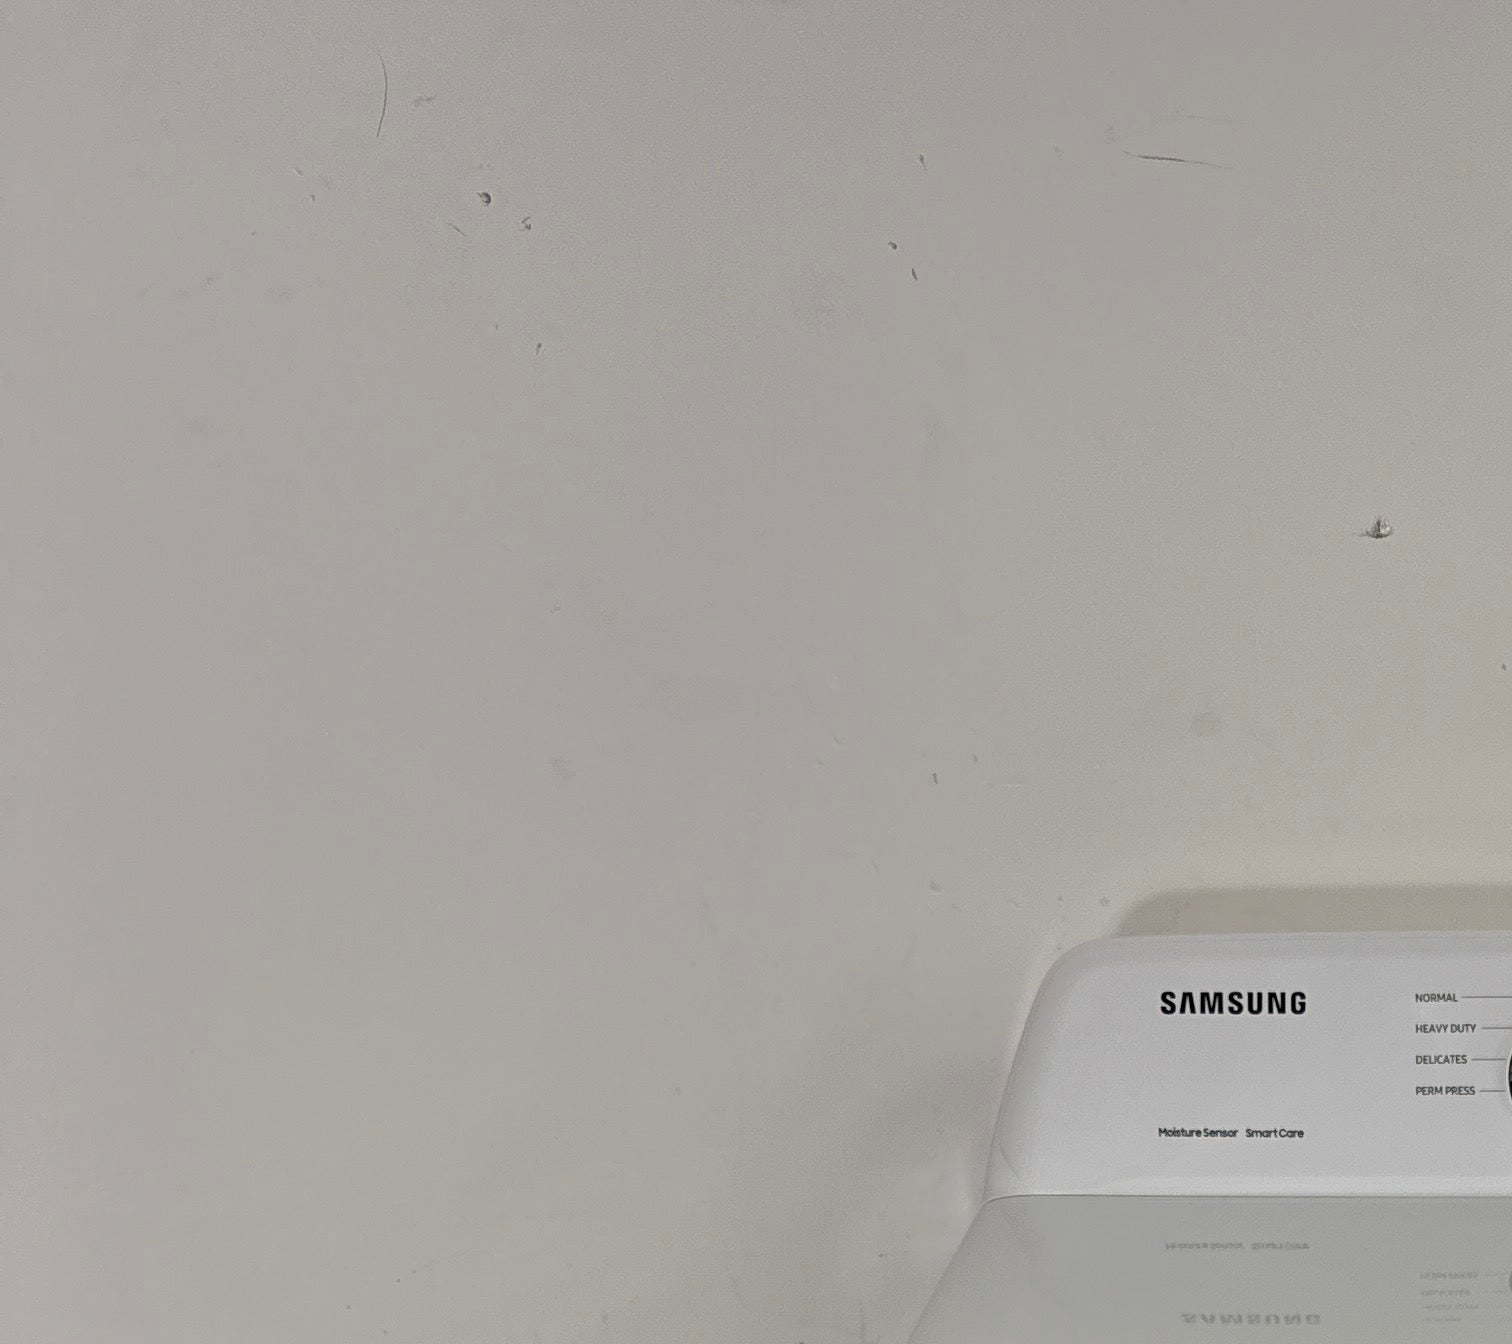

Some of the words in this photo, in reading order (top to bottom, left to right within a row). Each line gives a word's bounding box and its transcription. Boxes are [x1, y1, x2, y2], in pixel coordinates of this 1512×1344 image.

[1415, 993, 1458, 1002] NORMAL
[1160, 991, 1307, 1015] SAMSUNG
[1415, 1024, 1448, 1033] HEAVY
[1450, 1024, 1477, 1033] DUTY
[1415, 1055, 1468, 1065] DELICATES
[1415, 1086, 1443, 1096] PERM
[1445, 1086, 1476, 1096] PRESS
[1158, 1127, 1202, 1138] Moisture
[1203, 1128, 1238, 1138] Sensor
[1246, 1128, 1278, 1139] Smart
[1279, 1128, 1304, 1138] Care
